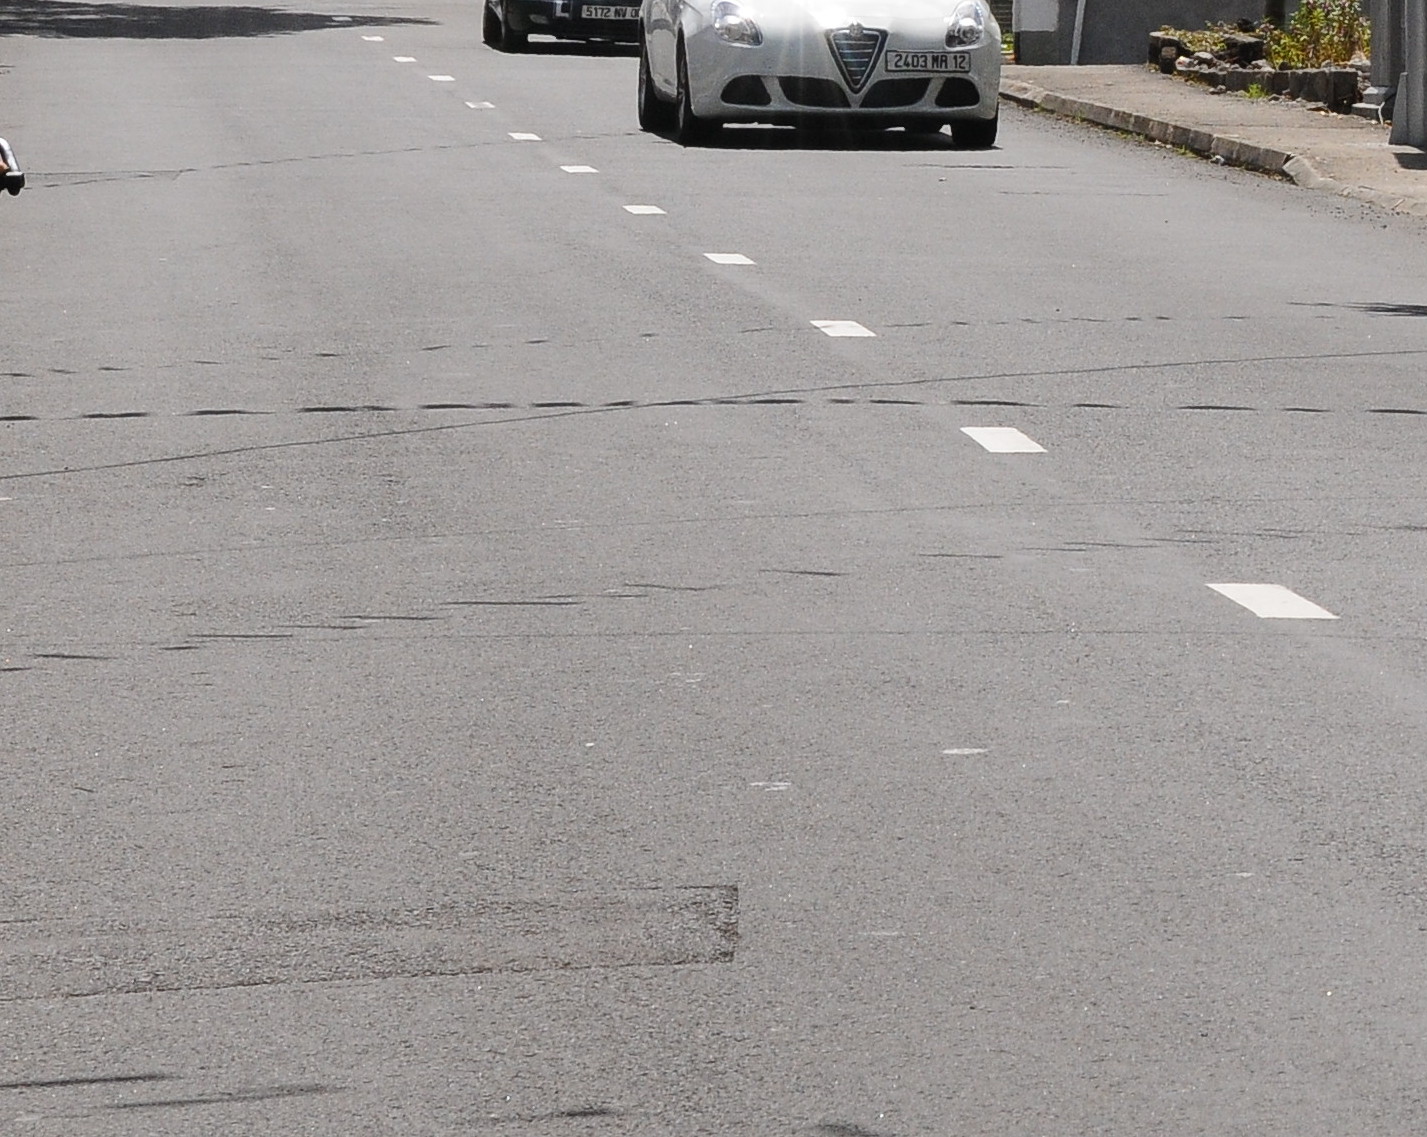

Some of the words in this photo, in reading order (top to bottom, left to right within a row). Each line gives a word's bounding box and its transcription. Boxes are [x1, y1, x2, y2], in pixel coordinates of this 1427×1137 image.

[586, 6, 611, 18] 5172
[614, 7, 628, 19] NV
[894, 53, 928, 69] 2403
[953, 54, 967, 70] 12
